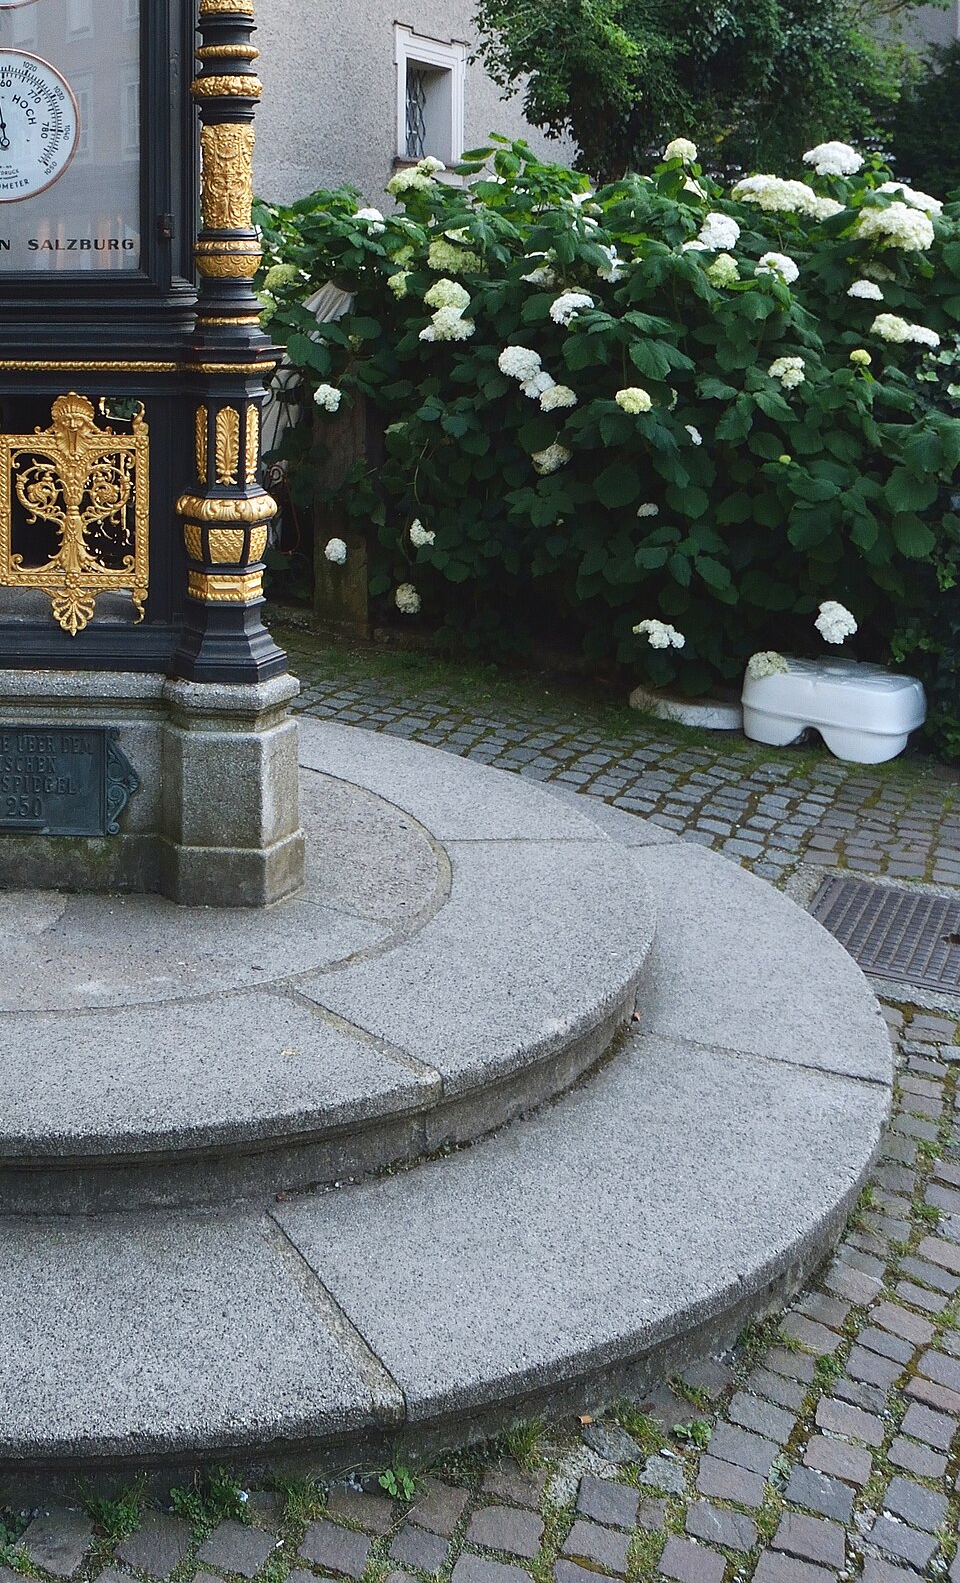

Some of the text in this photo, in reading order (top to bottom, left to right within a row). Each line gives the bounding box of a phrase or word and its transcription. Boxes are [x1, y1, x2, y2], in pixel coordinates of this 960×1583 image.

[23, 61, 38, 72] 1020
[27, 89, 41, 104] 770
[54, 86, 65, 101] 1030
[12, 95, 37, 125] HOCH
[41, 122, 50, 139] 780
[44, 161, 58, 175] 1050
[27, 238, 134, 251] SALZBURG
